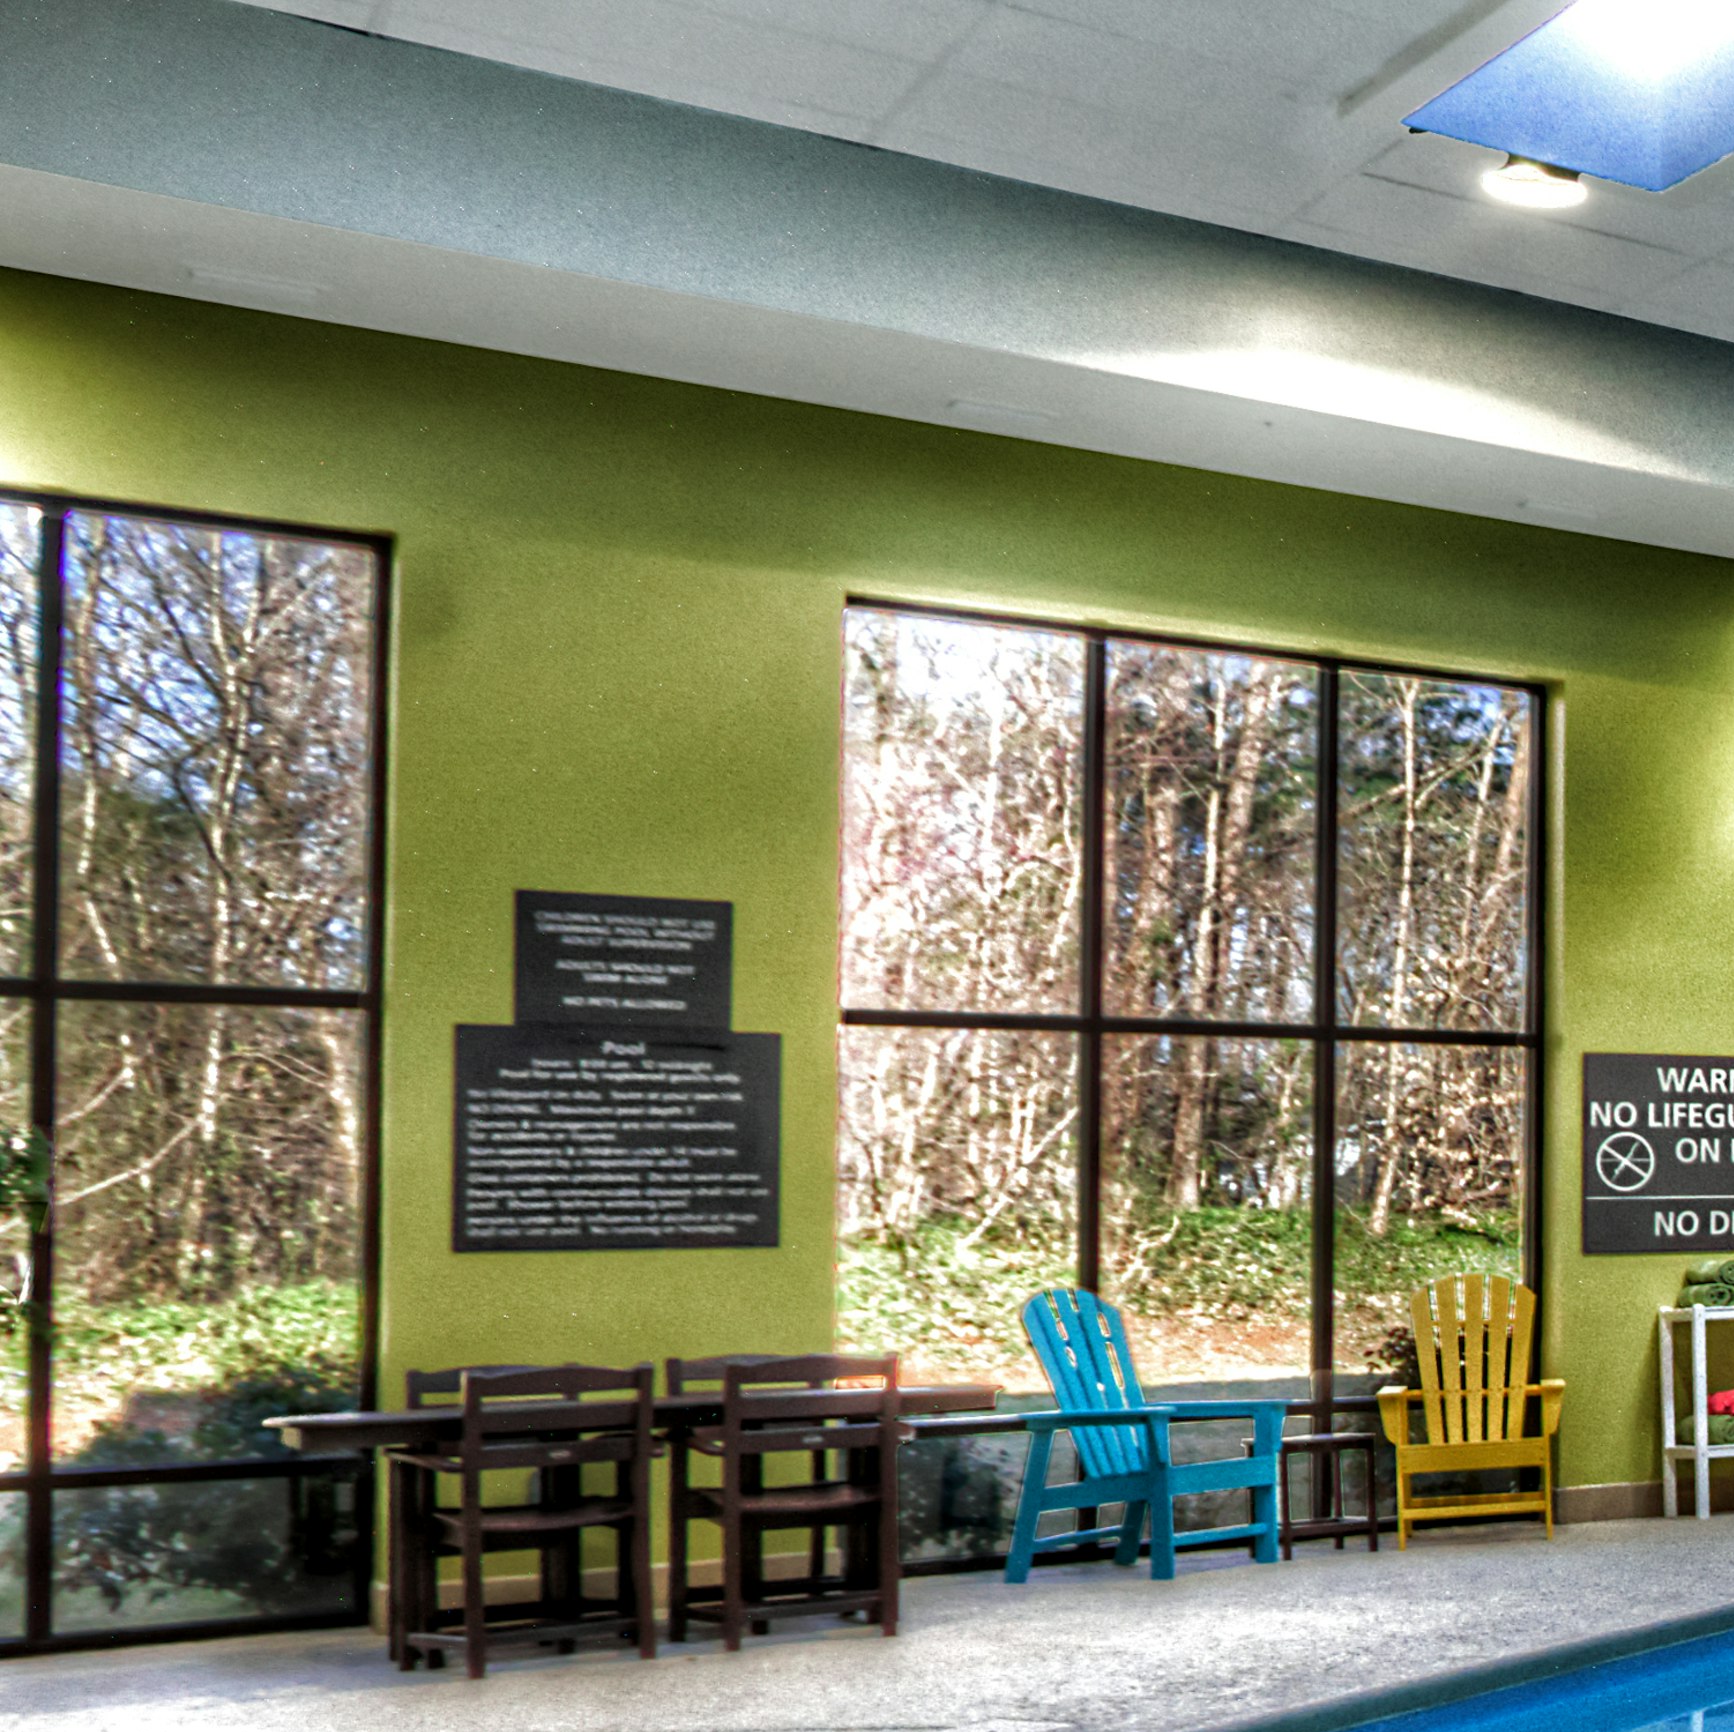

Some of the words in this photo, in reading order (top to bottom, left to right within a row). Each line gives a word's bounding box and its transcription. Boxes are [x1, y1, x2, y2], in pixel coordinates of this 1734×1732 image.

[602, 1040, 646, 1056] Pool
[1590, 1102, 1637, 1127] NO
[1675, 1138, 1720, 1163] ON
[1654, 1211, 1699, 1236] NO
